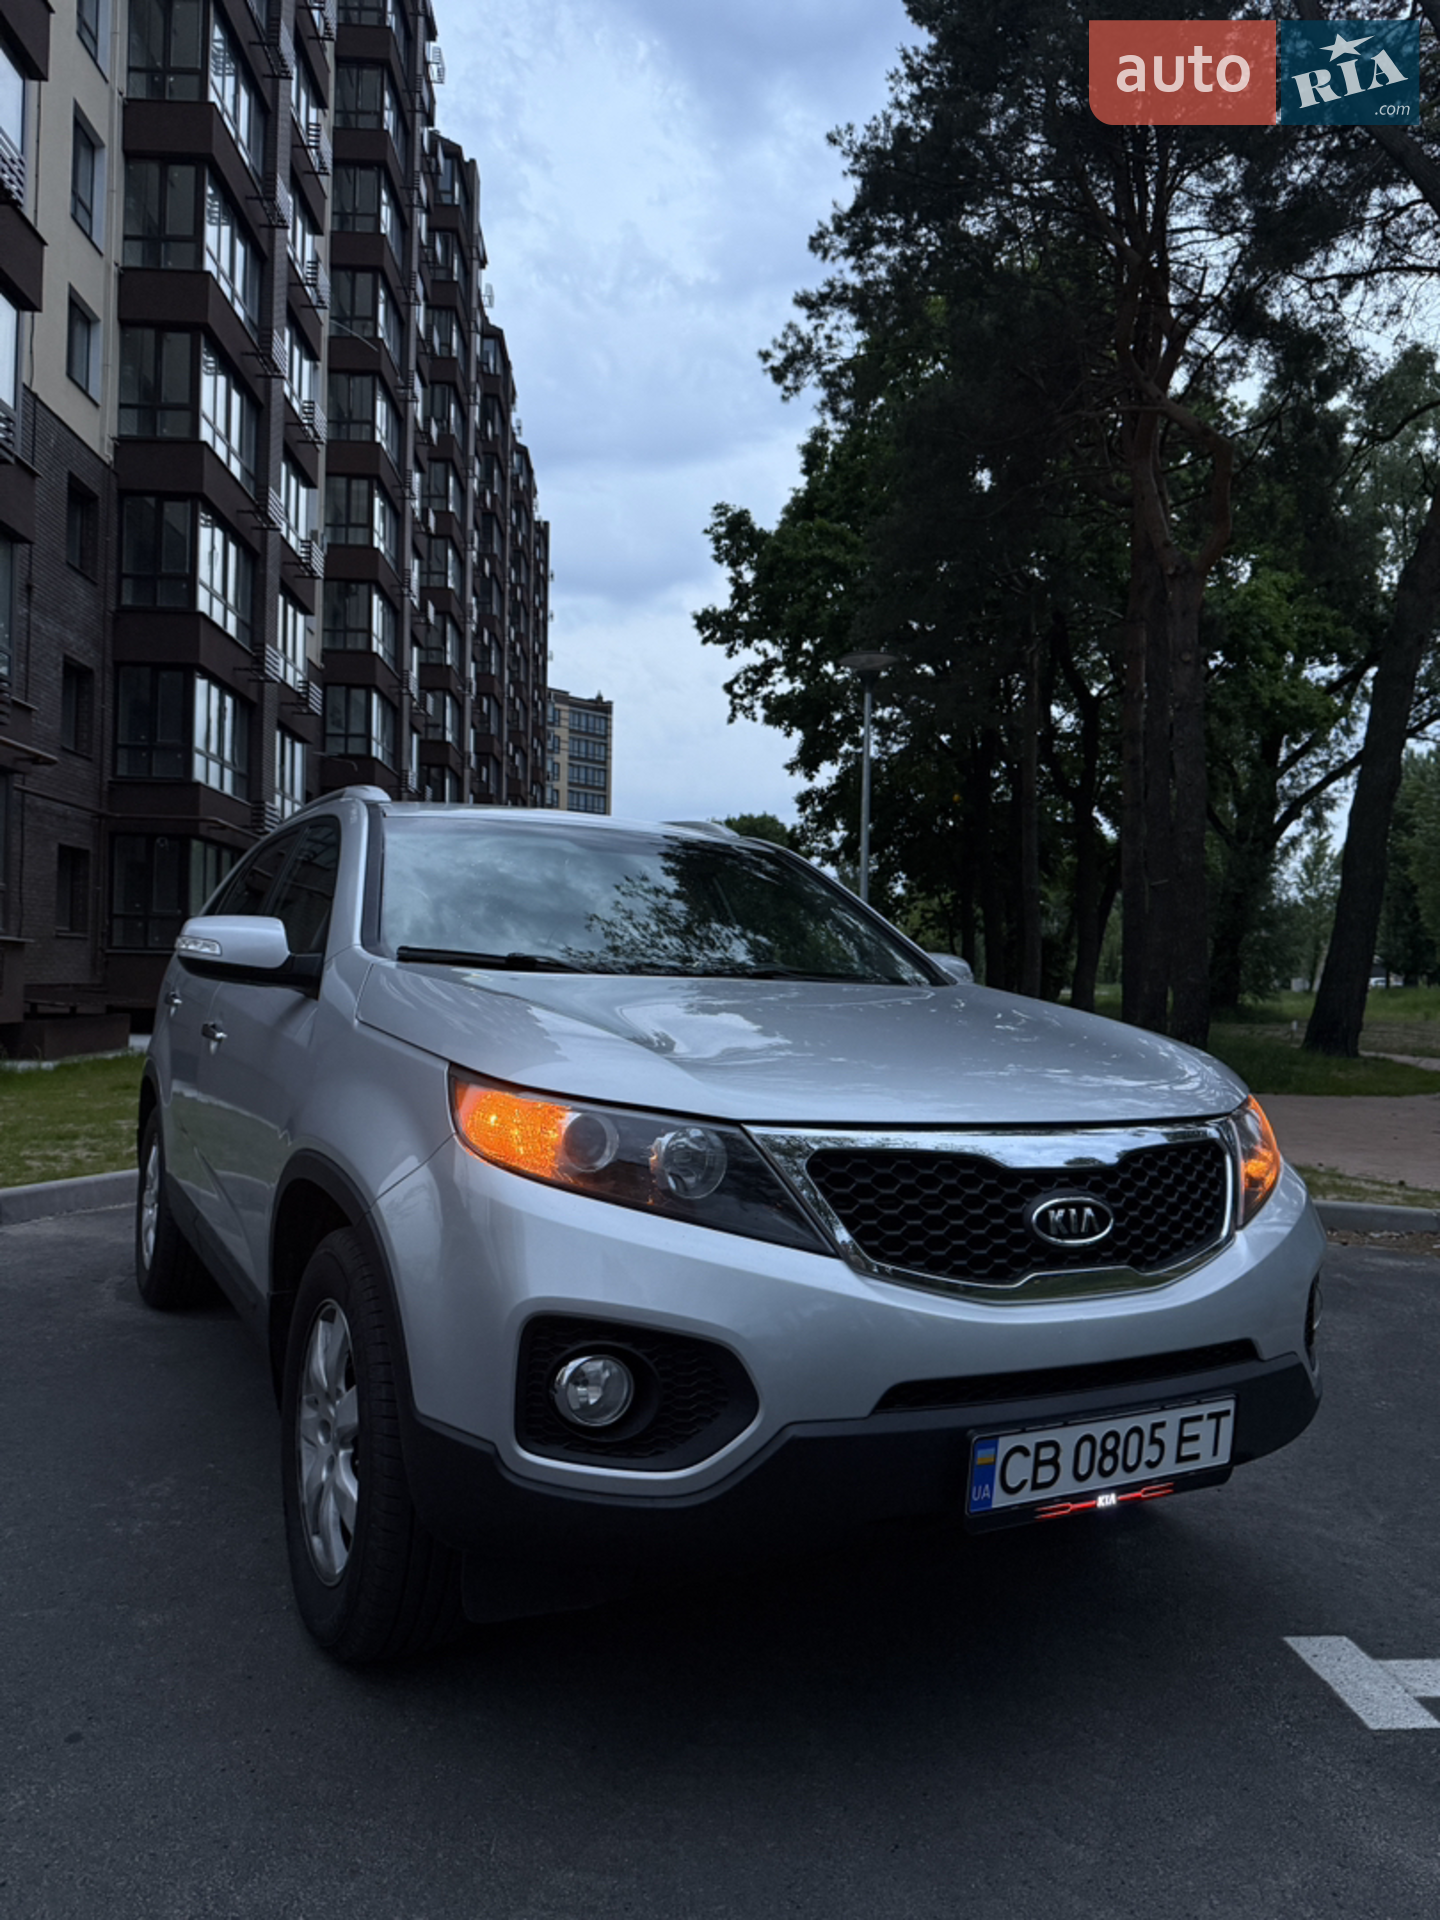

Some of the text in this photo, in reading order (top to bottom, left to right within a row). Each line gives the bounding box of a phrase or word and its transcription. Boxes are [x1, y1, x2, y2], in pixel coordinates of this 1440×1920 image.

[1048, 1207, 1100, 1235] KIA
[999, 1409, 1231, 1495] CB 0805 ET
[972, 1484, 991, 1501] UA
[1097, 1492, 1117, 1508] KIA
